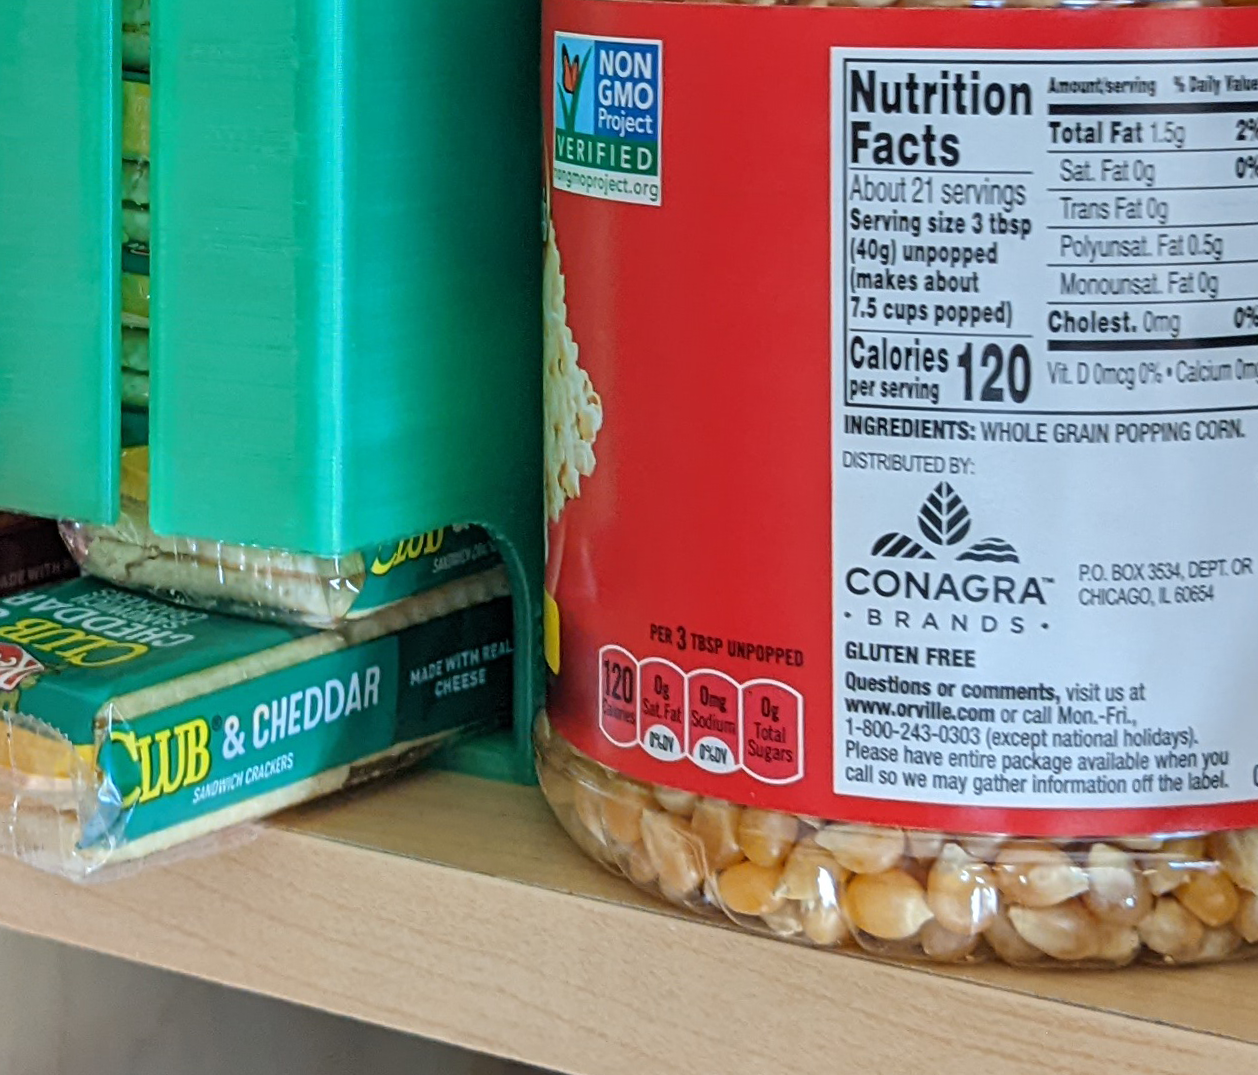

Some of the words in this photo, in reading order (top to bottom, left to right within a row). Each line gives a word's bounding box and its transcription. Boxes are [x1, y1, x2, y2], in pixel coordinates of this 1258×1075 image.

[599, 49, 652, 79] NON
[598, 79, 653, 110] GMO
[850, 69, 1032, 116] Nutrition
[1189, 75, 1221, 95] Daily
[1224, 75, 1258, 92] Value
[598, 108, 653, 137] Project
[1048, 121, 1103, 143] Total
[1110, 121, 1143, 143] Fat
[1150, 121, 1186, 148] 1.5g
[556, 135, 653, 170] VERIFIED
[850, 121, 960, 167] Facts
[1060, 159, 1095, 182] Sat.
[1101, 159, 1129, 182] Fat
[1133, 159, 1156, 187] 0g
[850, 174, 906, 203] About
[911, 176, 933, 203] 21
[941, 177, 1027, 212] servings
[850, 208, 921, 237] Serving
[927, 211, 965, 234] size
[971, 213, 983, 234] 3
[989, 213, 1032, 240] tbsp
[1059, 197, 1110, 219] Trans
[1114, 197, 1143, 219] Fat
[1146, 197, 1169, 224] 0g
[850, 238, 896, 265] (40g)
[903, 242, 998, 268] unpopped
[1060, 234, 1153, 263] Polyunsat.
[1157, 234, 1184, 256] Fat
[1187, 233, 1223, 260] 0.5g
[850, 267, 918, 293] (makes
[924, 270, 980, 293] about
[1060, 272, 1163, 295] Monounsat.
[1168, 271, 1194, 294] Fat
[1198, 271, 1219, 298] 0g
[850, 296, 877, 318] 7.5
[883, 302, 928, 325] cups
[935, 301, 1012, 328] popped)
[1048, 310, 1137, 333] Cholest.
[1143, 310, 1181, 338] 0mg
[850, 335, 949, 372] Calories
[957, 342, 1032, 404] 120
[1047, 361, 1073, 384] Vit.
[1077, 362, 1090, 384] D
[1093, 362, 1135, 390] 0mcg
[1139, 362, 1163, 384] 0%
[1176, 359, 1232, 383] Calcium
[1235, 358, 1258, 384] 0m
[850, 379, 875, 400] per
[880, 377, 939, 404] serving
[844, 414, 976, 441] INGREDIENTS:
[981, 421, 1048, 443] WHOLE
[1053, 423, 1109, 443] GRAIN
[1115, 421, 1190, 443] POPPING
[1196, 418, 1245, 441] CORN.
[843, 450, 945, 473] DISTRIBUTED
[949, 457, 975, 475] BY:
[1078, 564, 1107, 582] P.O.
[1112, 563, 1145, 581] BOX
[1148, 562, 1185, 582] 3534,
[1188, 559, 1229, 578] DEPT.
[1231, 557, 1253, 575] OR
[1078, 587, 1155, 607] CHICAGO,
[1158, 587, 1172, 604] IL
[1174, 585, 1214, 603] 60654
[1, 591, 195, 647] CHEDDAR
[867, 608, 1025, 634] BRANDS
[650, 624, 672, 644] PER
[676, 626, 687, 650] 3
[691, 633, 723, 655] TBSP
[728, 639, 804, 667] UNPOPPED
[845, 641, 919, 665] GLUTEN
[926, 647, 976, 668] FREE
[410, 660, 443, 686] MADE
[445, 649, 480, 673] WITH
[482, 638, 514, 661] REAL
[435, 667, 487, 698] CHEESE
[603, 659, 634, 704] 120
[654, 675, 670, 700] 0g
[845, 671, 931, 697] Questions
[937, 683, 956, 697] or
[961, 683, 1061, 704] comments,
[1065, 683, 1101, 702] visit
[1105, 686, 1124, 701] us
[1129, 683, 1146, 701] at
[663, 703, 682, 723] Fat
[699, 685, 727, 713] 0mg
[761, 696, 780, 721] 0g
[845, 697, 995, 723] www.orville.com
[1000, 708, 1018, 723] or
[1022, 706, 1052, 724] call
[1057, 706, 1138, 726] Mon.-Fri.,
[109, 717, 211, 808] CLUB
[221, 714, 246, 760] &
[252, 665, 381, 749] CHEDDAR
[691, 710, 736, 735] Sodium
[754, 722, 786, 744] Total
[845, 717, 980, 745] 1-800-243-0303
[985, 726, 1048, 750] (except
[1052, 729, 1118, 748] national
[1123, 726, 1199, 749] holidays).
[748, 740, 793, 764] Sugars
[845, 739, 898, 762] Please
[903, 745, 942, 766] have
[948, 750, 996, 769] entire
[1002, 753, 1072, 774] package
[1077, 752, 1149, 771] available
[1154, 751, 1197, 769] when
[1201, 750, 1229, 771] you
[192, 771, 244, 804] SANDWICH
[245, 752, 294, 786] CRACKERS
[845, 765, 873, 783] call
[878, 770, 897, 785] so
[903, 773, 927, 787] we
[932, 775, 967, 795] may
[973, 774, 1027, 795] gather
[1032, 774, 1127, 793] information
[1132, 774, 1154, 793] off
[1158, 773, 1183, 792] the
[1188, 770, 1229, 790] label.
